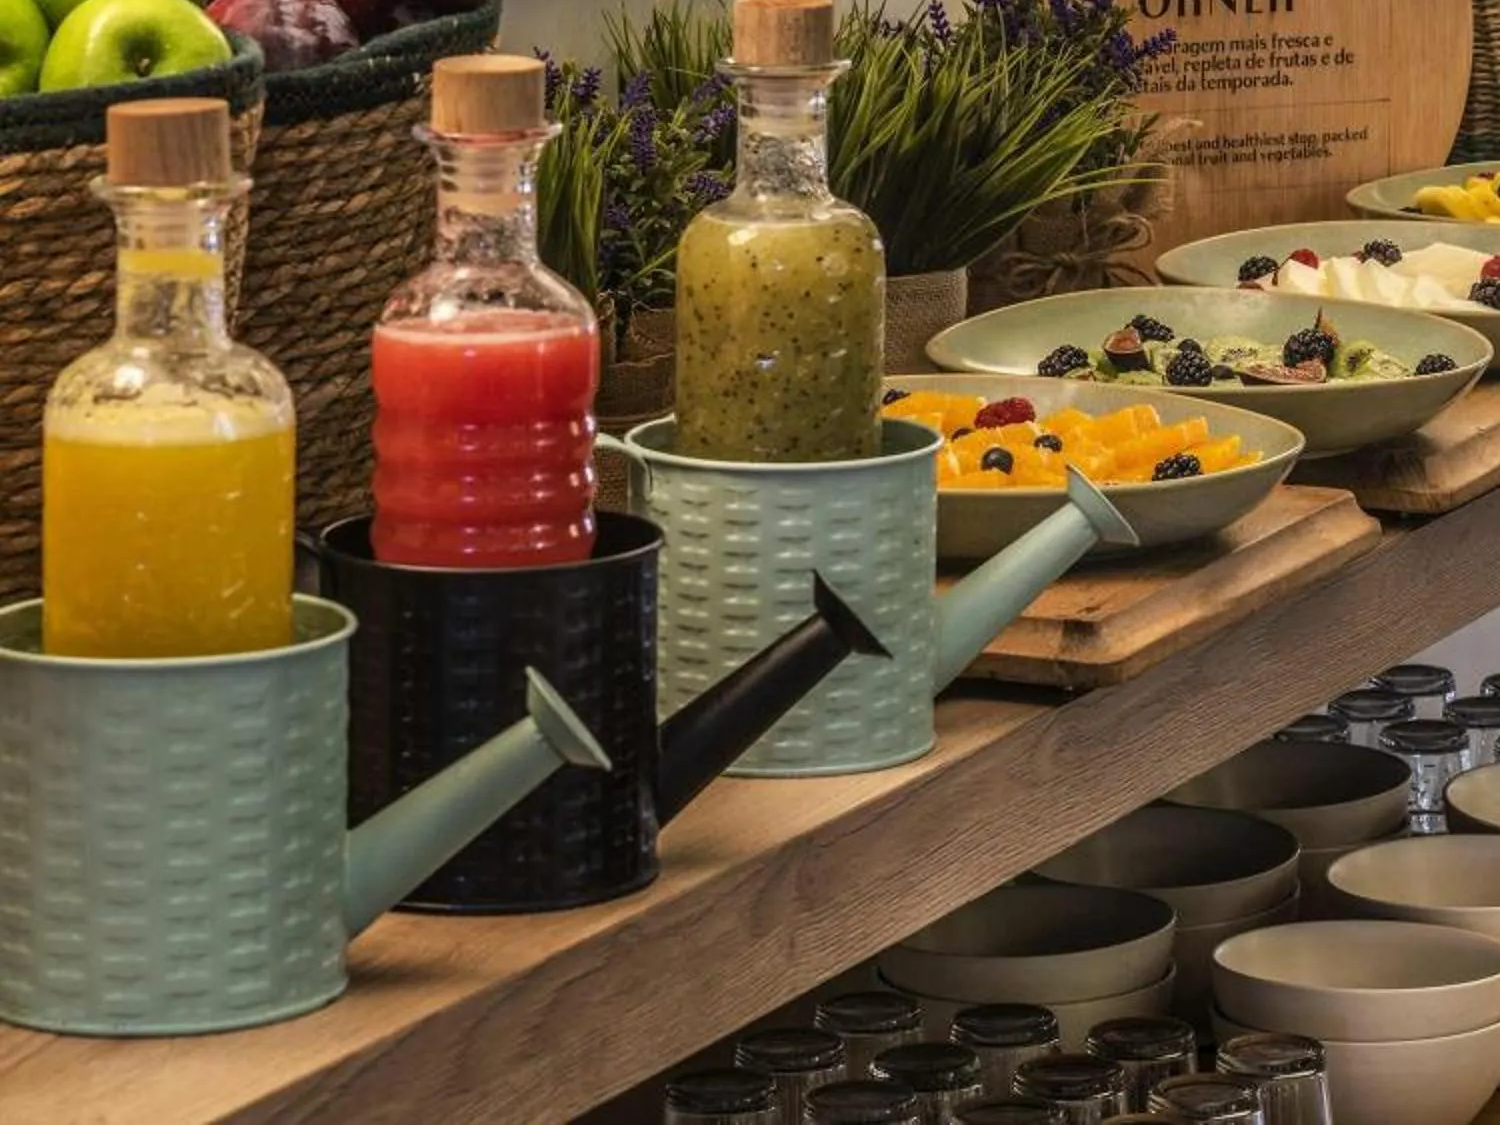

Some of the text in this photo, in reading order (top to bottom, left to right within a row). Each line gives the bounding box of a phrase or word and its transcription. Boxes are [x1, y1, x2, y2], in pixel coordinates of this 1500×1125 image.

[1230, 33, 1267, 51] mais
[1271, 32, 1321, 50] fresca
[1323, 34, 1334, 48] e
[1183, 53, 1242, 78] repleta
[1244, 51, 1266, 70] de
[1269, 50, 1318, 69] frutas
[1320, 53, 1331, 66] e
[1333, 46, 1355, 65] de
[1176, 74, 1196, 93] da
[1200, 70, 1294, 95] temporada.
[1195, 132, 1220, 151] and
[1222, 129, 1286, 150] healthiest
[1320, 124, 1369, 146] packed
